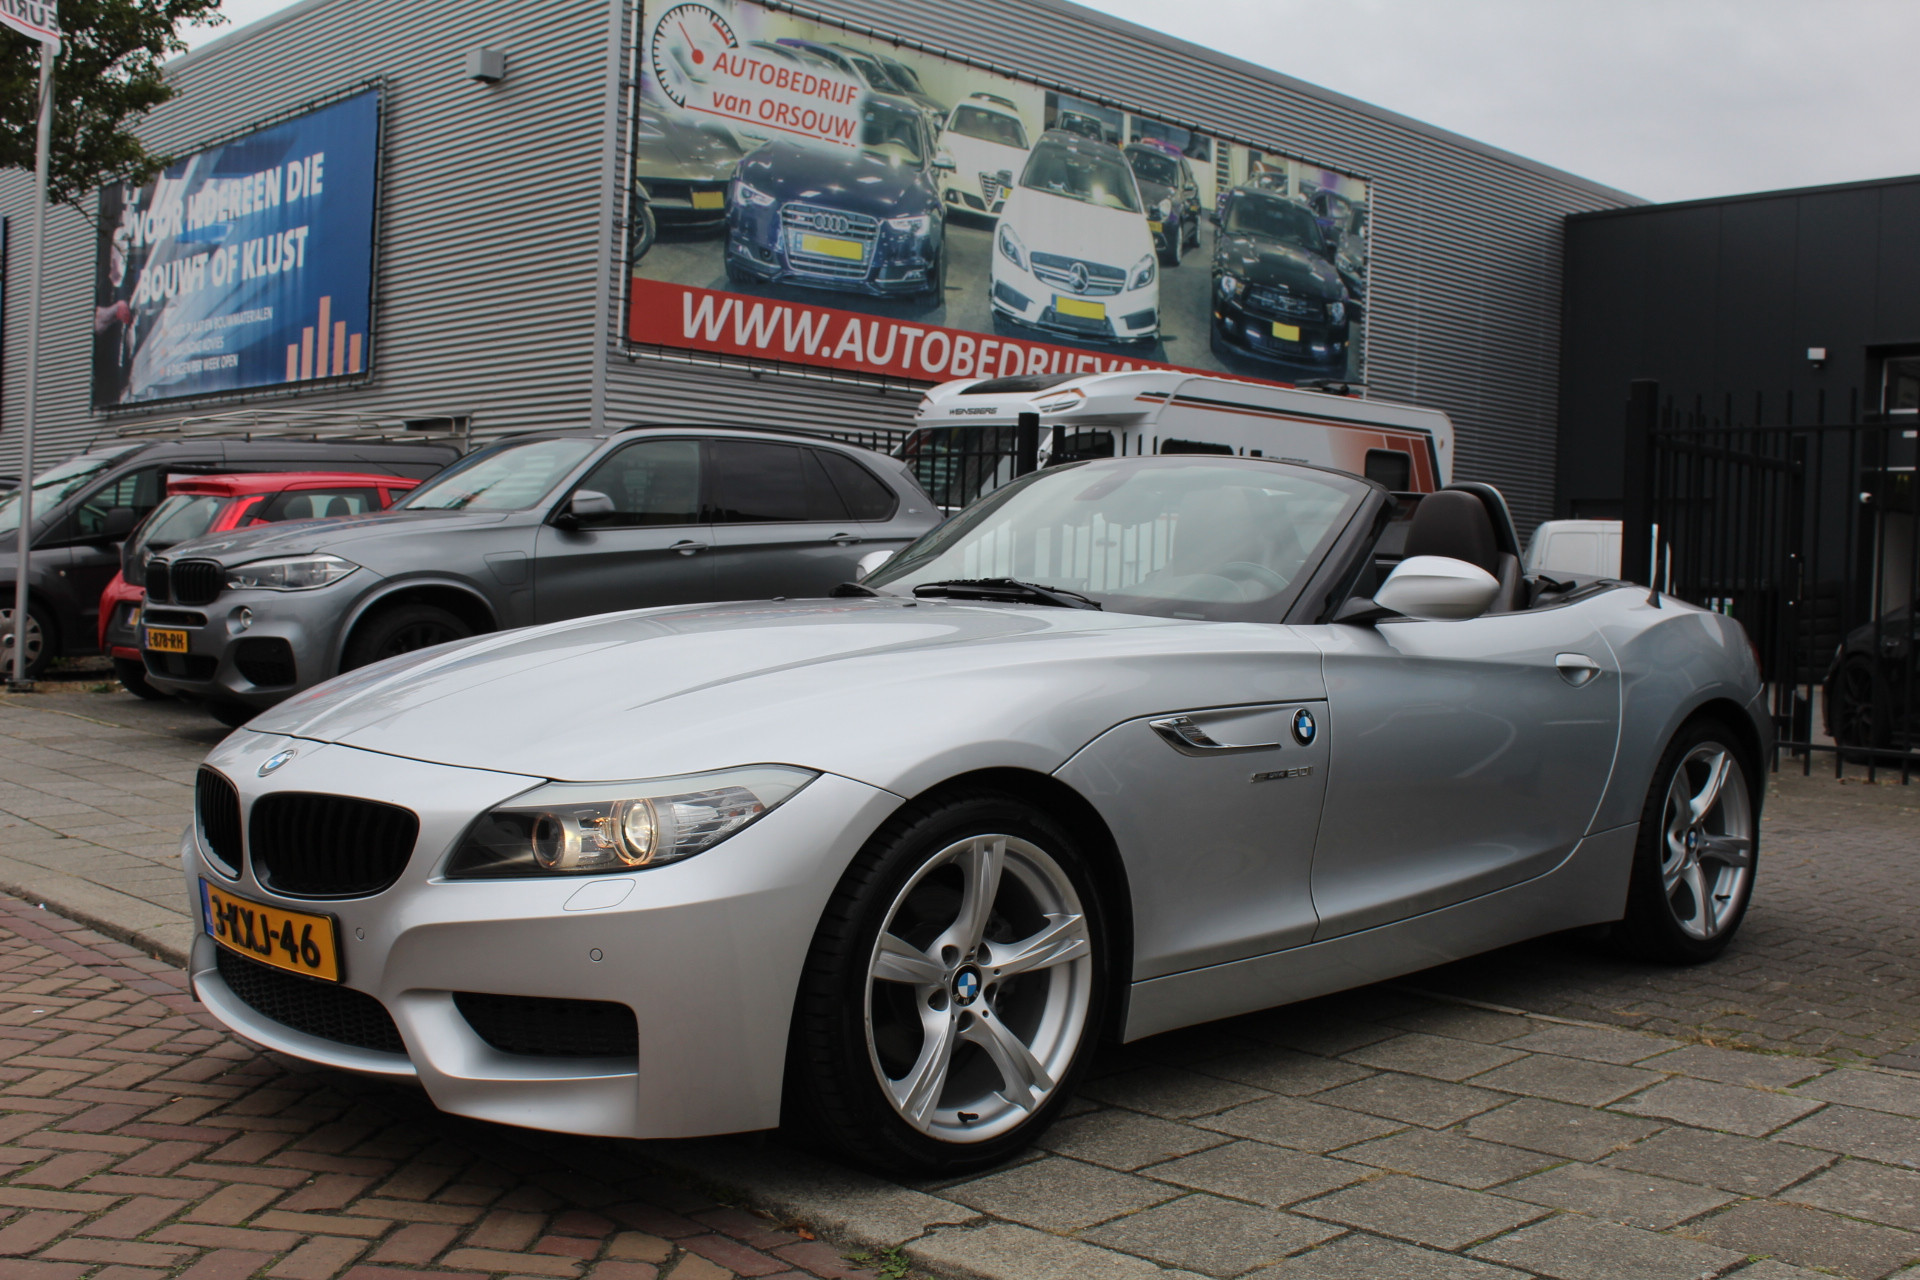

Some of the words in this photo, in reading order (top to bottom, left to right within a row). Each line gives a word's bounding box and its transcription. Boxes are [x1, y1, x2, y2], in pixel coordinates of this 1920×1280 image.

[712, 52, 858, 105] AUTOBEDRIJF
[713, 91, 751, 115] van
[759, 99, 856, 139] ORSOUW
[133, 198, 184, 247] VOOR
[286, 152, 325, 203] DIE
[139, 252, 209, 304] BOUWT
[212, 245, 239, 287] OF
[242, 225, 309, 281] KLUST
[683, 291, 1240, 379] WWW.AUTOBEDRIJF
[211, 894, 322, 968] 3-KXJ-46
